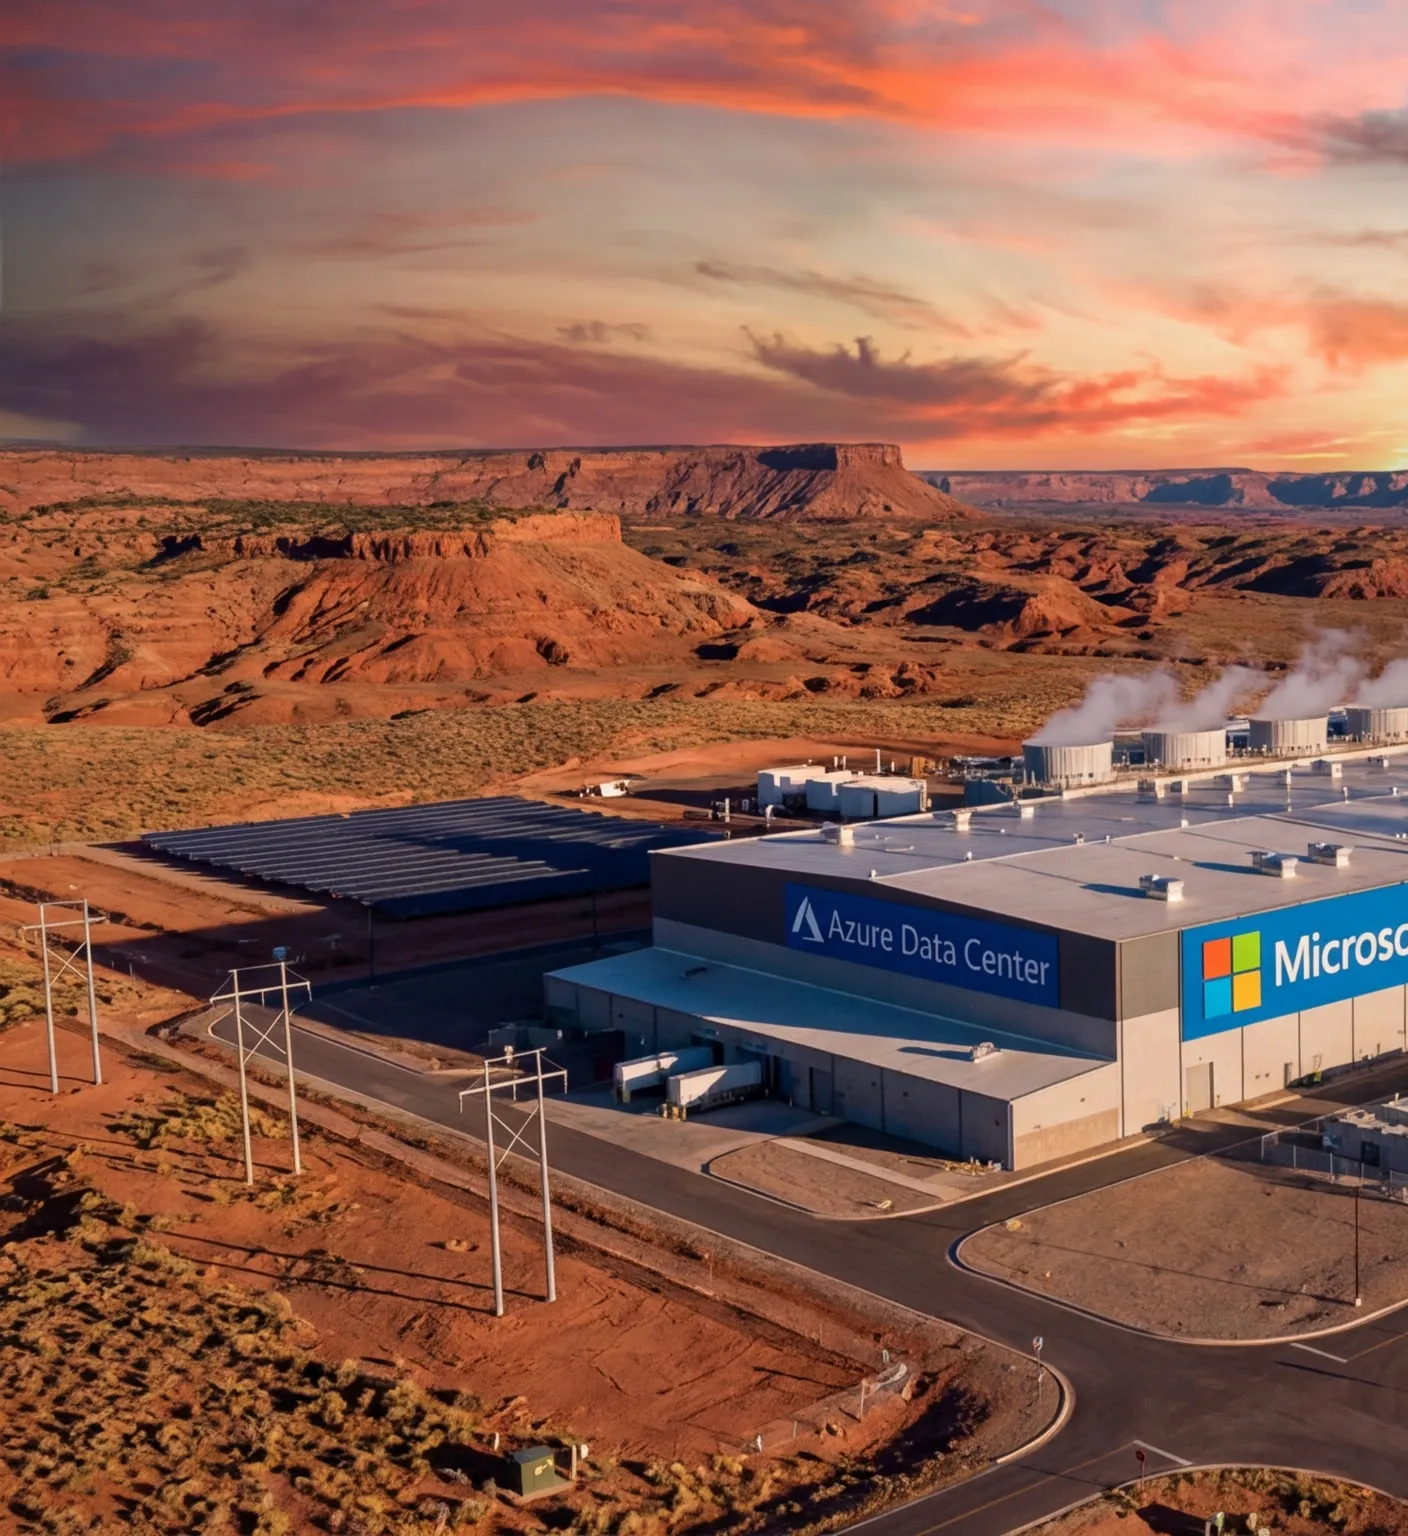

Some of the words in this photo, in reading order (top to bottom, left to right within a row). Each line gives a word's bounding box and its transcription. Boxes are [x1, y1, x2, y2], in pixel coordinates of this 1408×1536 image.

[828, 909, 893, 952] Azure
[901, 924, 956, 966] Data
[964, 938, 1050, 985] Center
